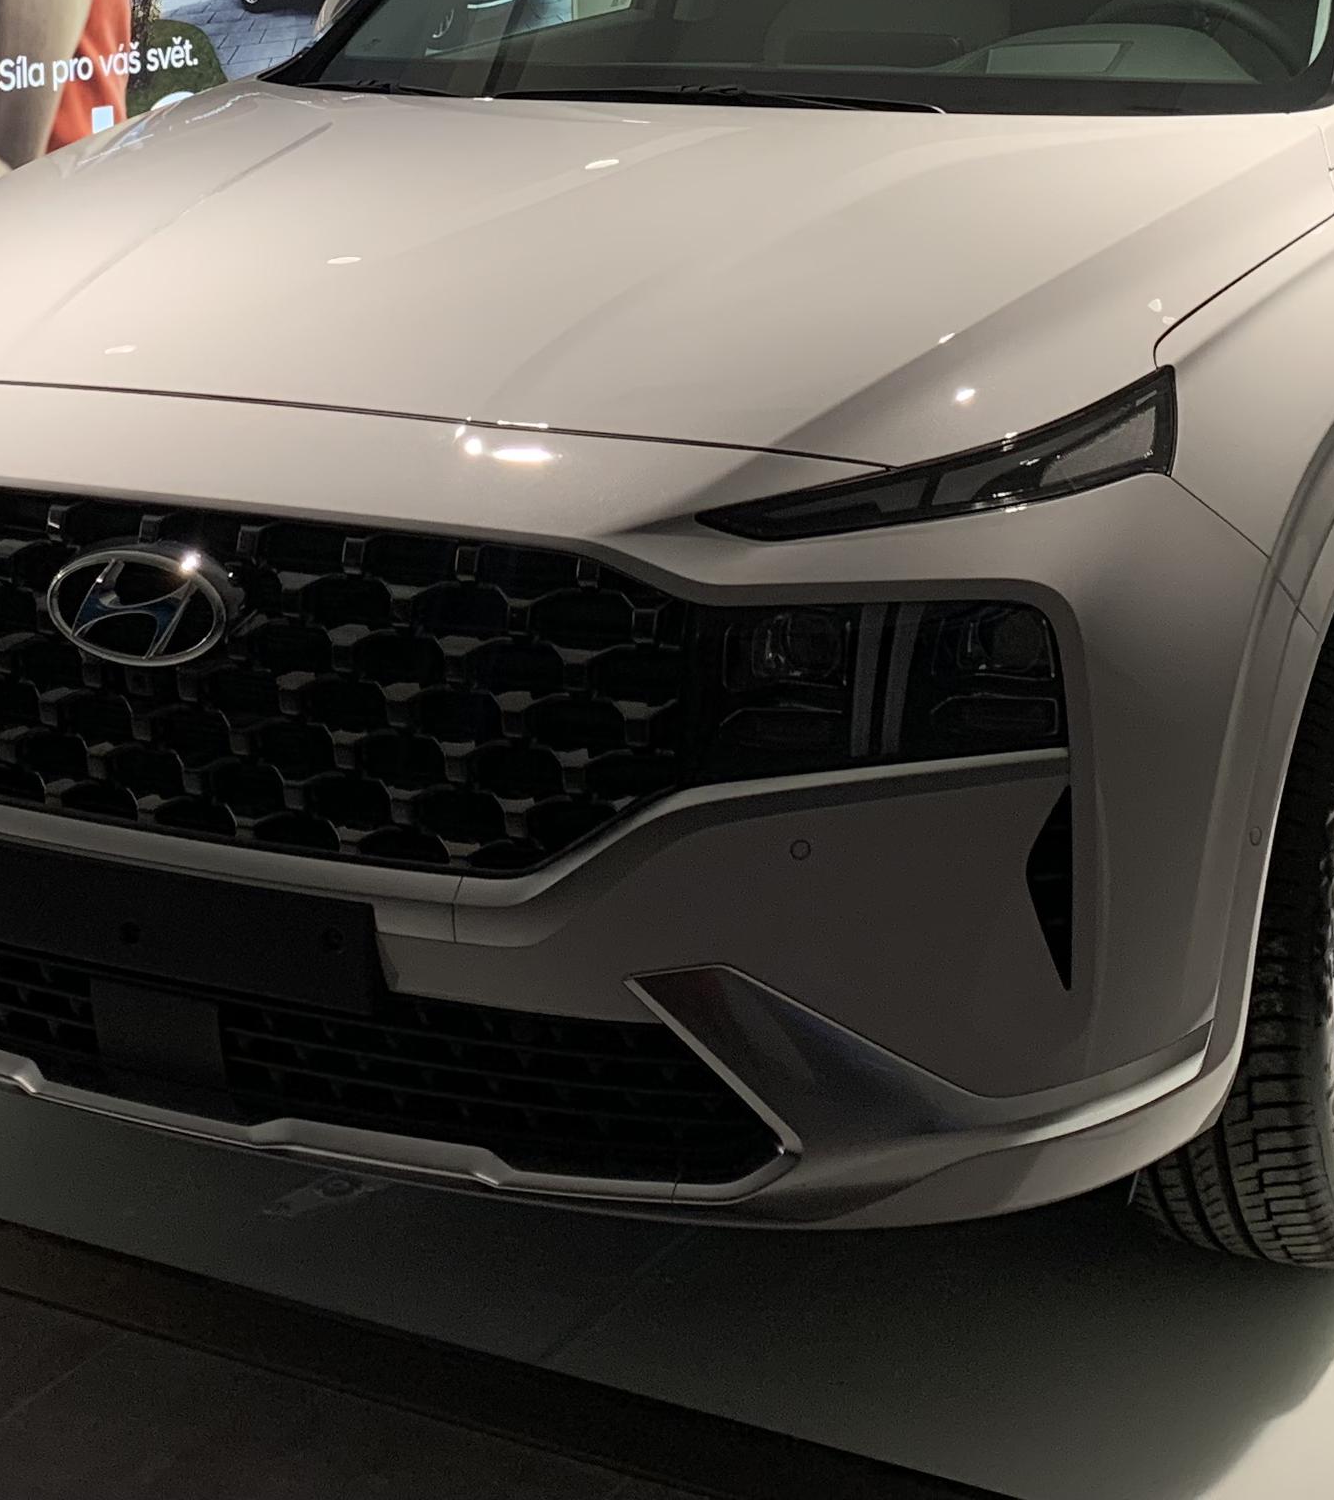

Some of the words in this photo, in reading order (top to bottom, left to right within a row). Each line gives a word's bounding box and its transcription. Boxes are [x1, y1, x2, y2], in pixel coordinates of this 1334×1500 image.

[51, 55, 94, 92] pro
[99, 40, 142, 78] váš
[146, 35, 200, 73] svět.
